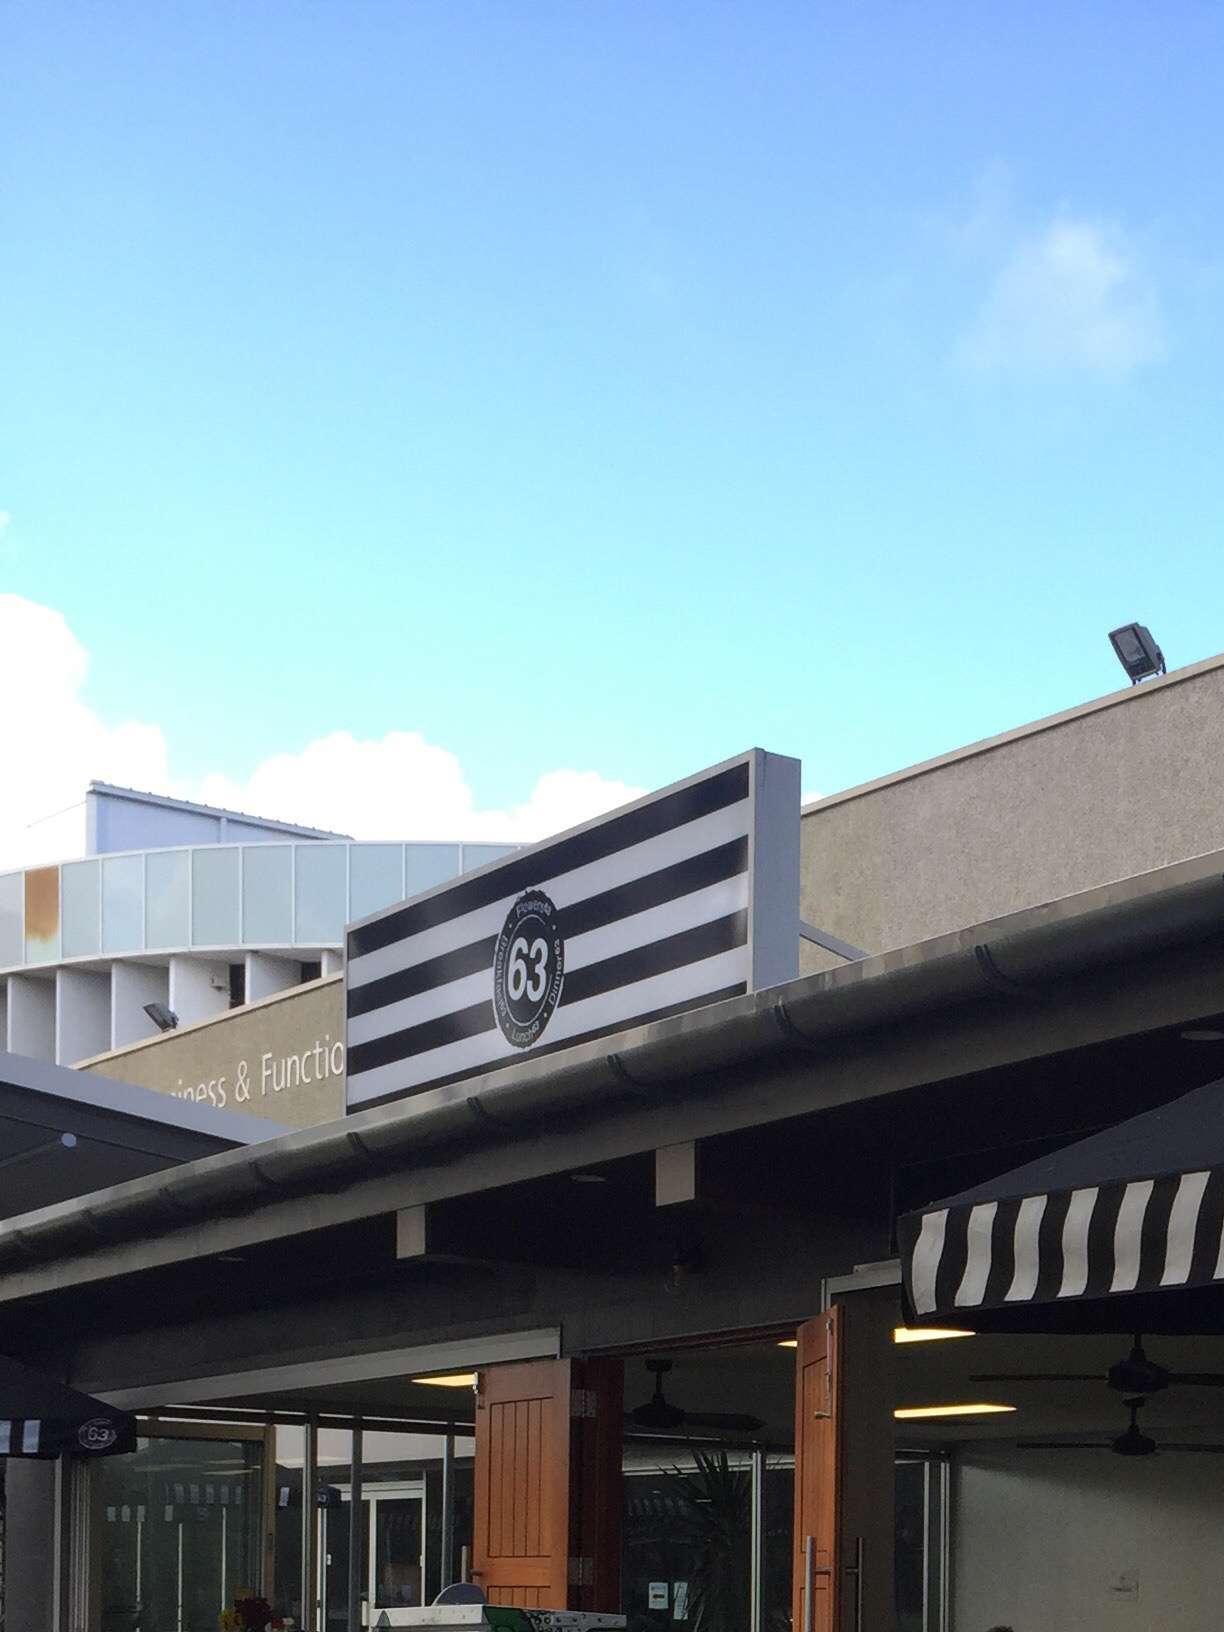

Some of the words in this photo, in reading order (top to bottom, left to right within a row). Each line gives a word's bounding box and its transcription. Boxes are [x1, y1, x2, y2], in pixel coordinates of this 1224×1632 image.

[507, 936, 549, 1003] 63
[235, 1060, 250, 1102] &
[87, 1426, 110, 1441] 63
